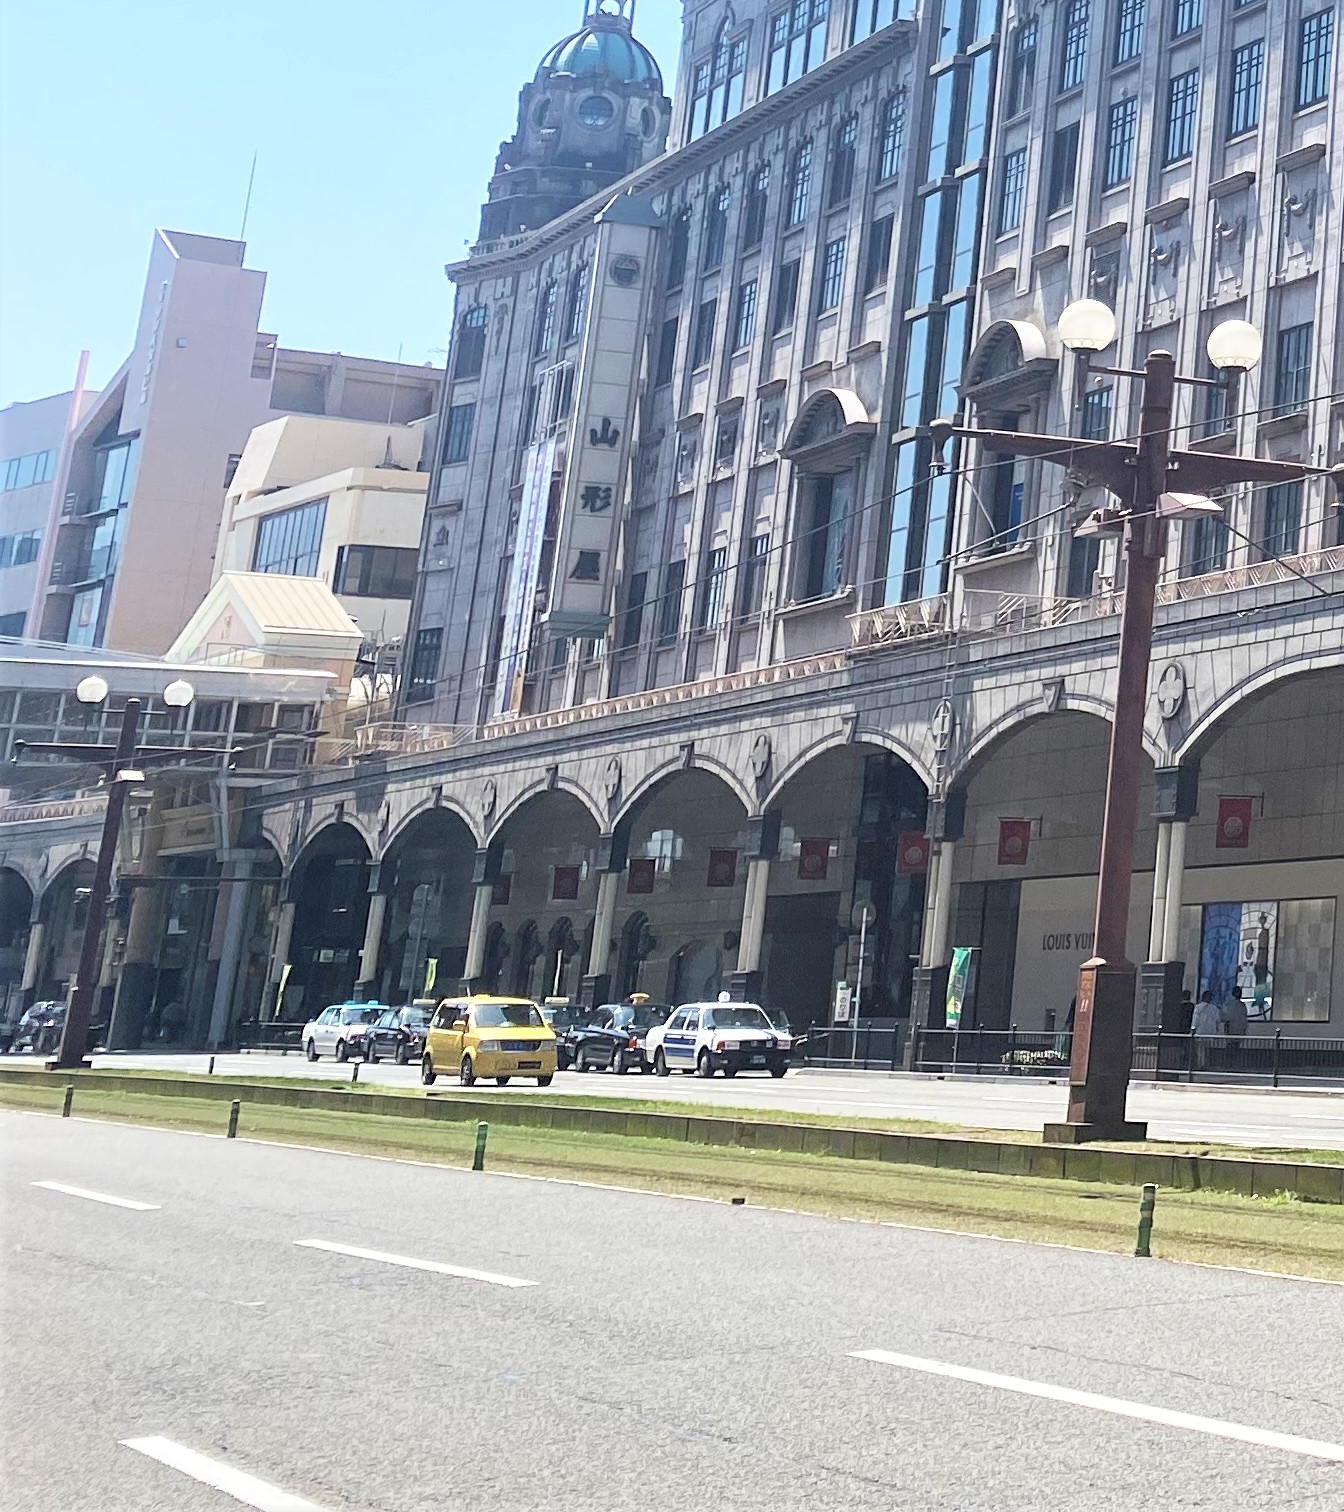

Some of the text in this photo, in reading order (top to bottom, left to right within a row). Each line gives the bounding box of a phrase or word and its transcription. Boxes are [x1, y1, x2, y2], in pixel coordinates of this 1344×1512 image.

[569, 418, 621, 580] 山形屋
[1042, 932, 1096, 951] LOUIS VUIT
